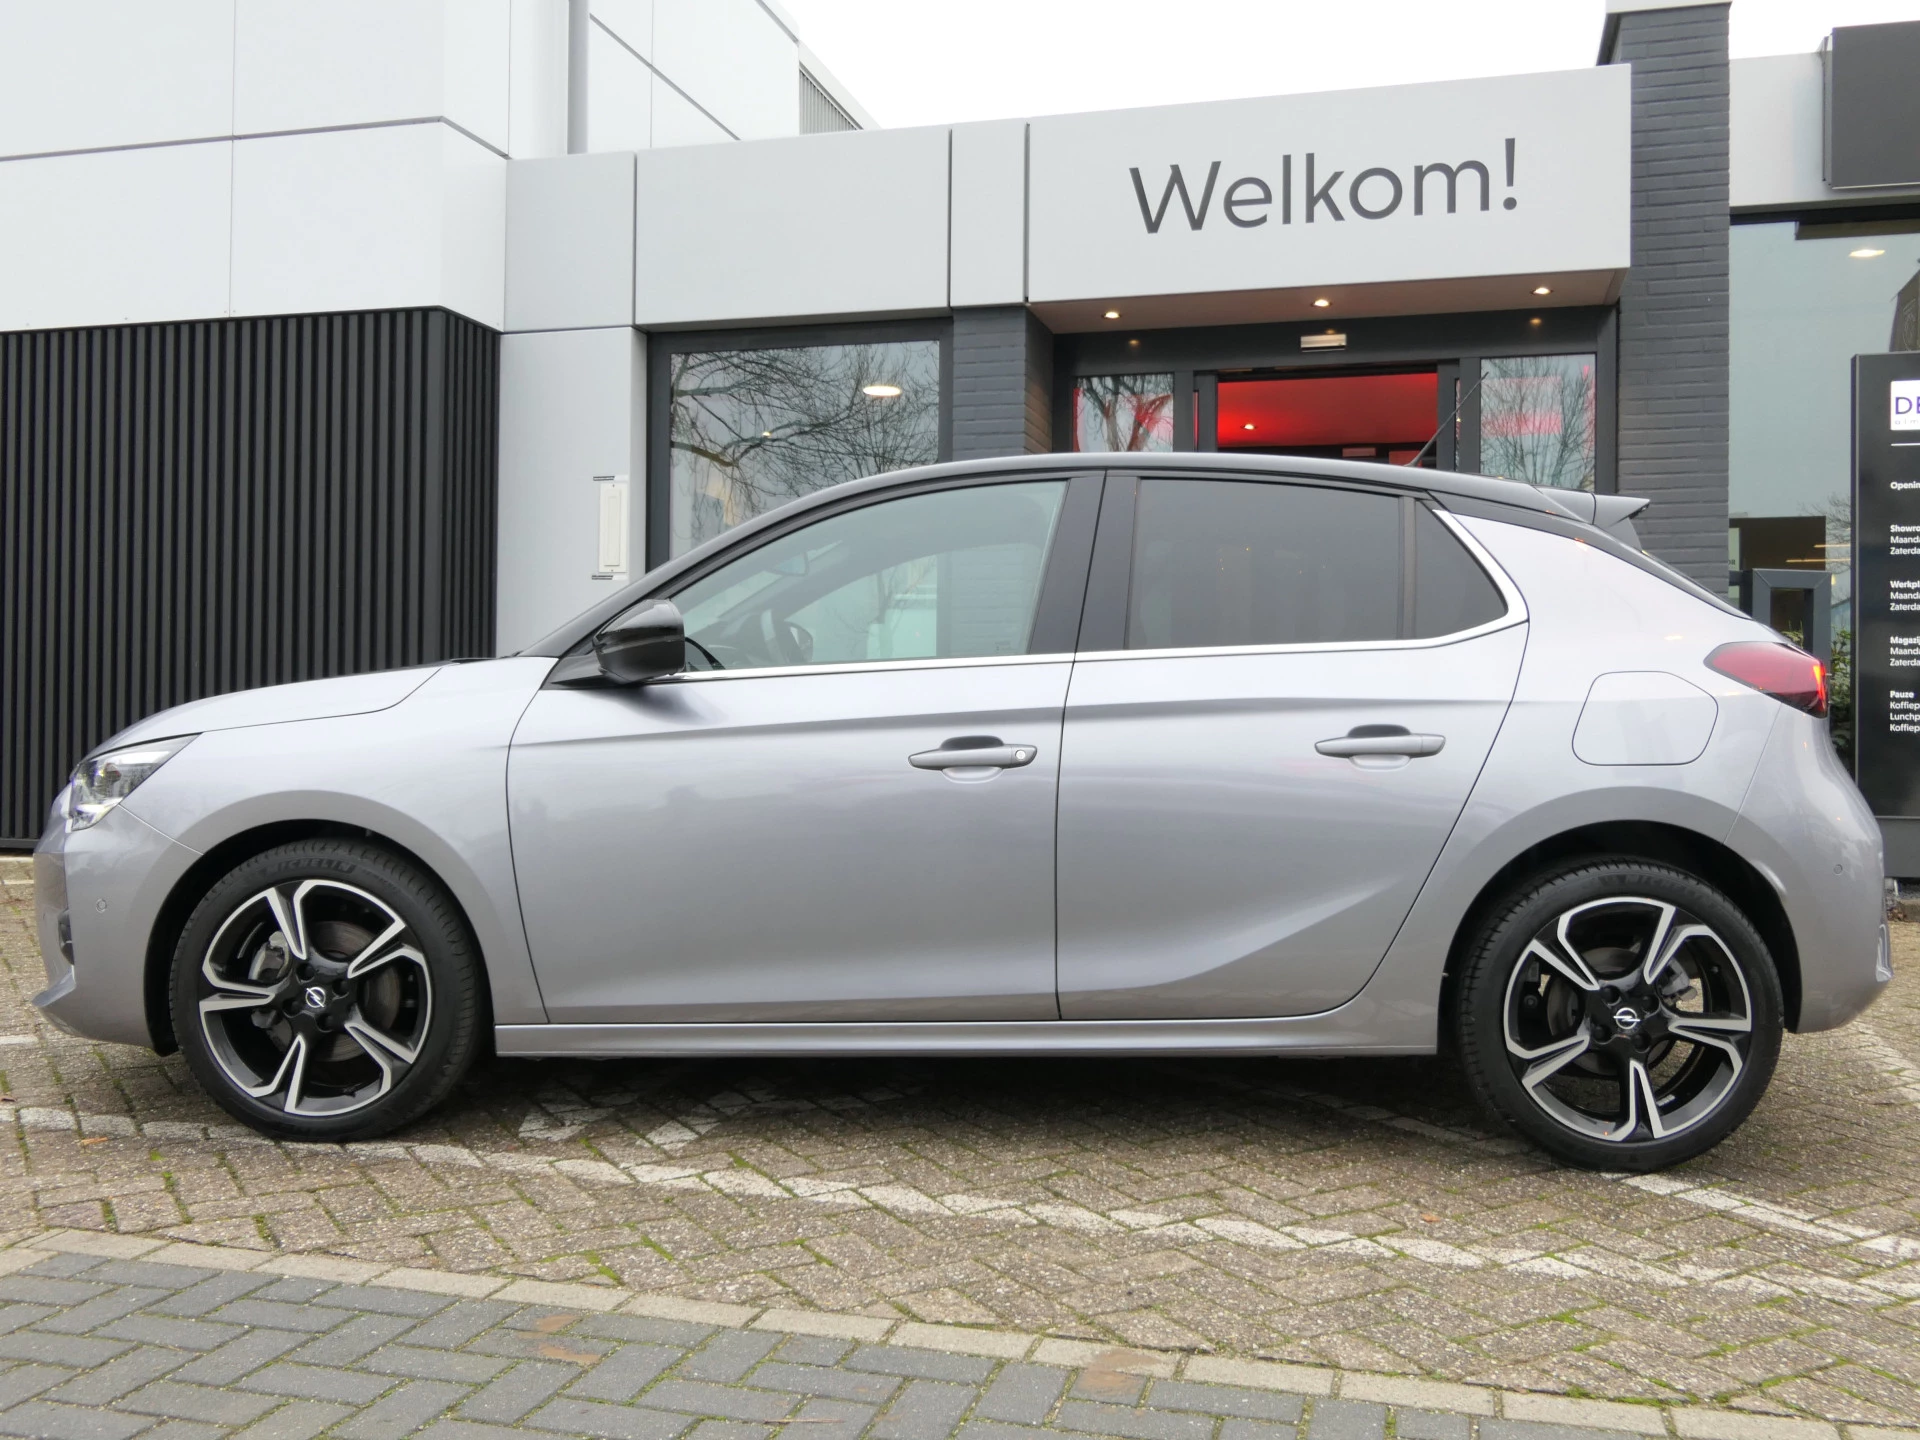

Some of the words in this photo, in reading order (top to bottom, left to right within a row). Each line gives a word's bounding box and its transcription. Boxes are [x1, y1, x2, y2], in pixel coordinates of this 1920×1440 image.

[1129, 137, 1517, 234] Welkom!
[1890, 690, 1914, 698] Pauze
[1890, 701, 1920, 711] Koffiep
[1890, 712, 1920, 722] Lunchp
[1890, 723, 1920, 733] Koffiep
